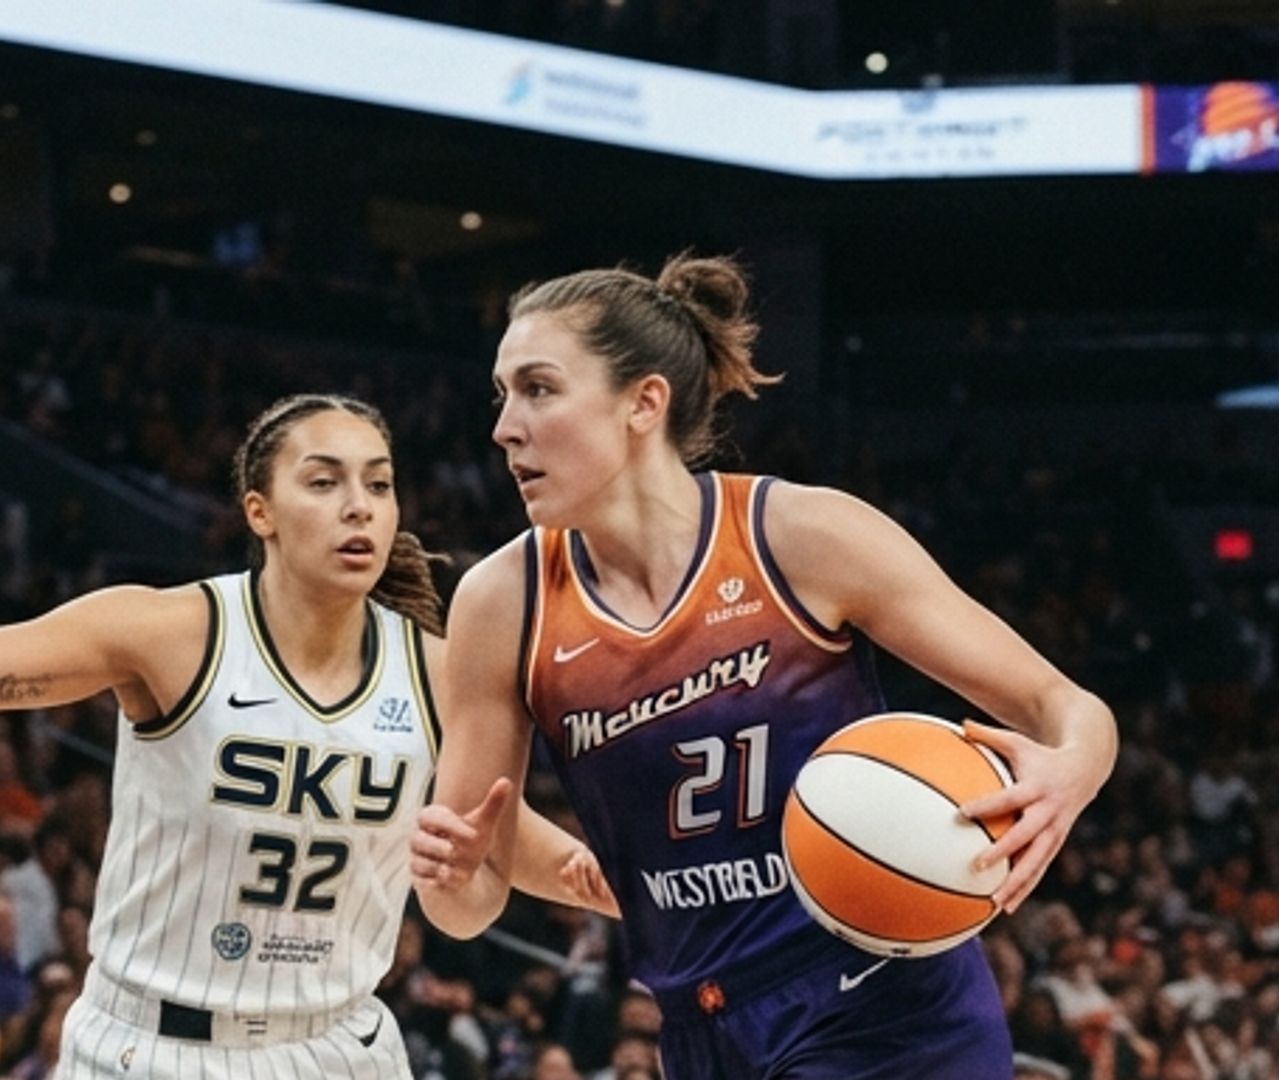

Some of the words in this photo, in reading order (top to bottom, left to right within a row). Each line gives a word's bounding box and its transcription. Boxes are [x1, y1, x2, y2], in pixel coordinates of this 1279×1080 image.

[211, 738, 410, 826] SKY
[669, 723, 770, 840] 21
[239, 831, 351, 914] 32
